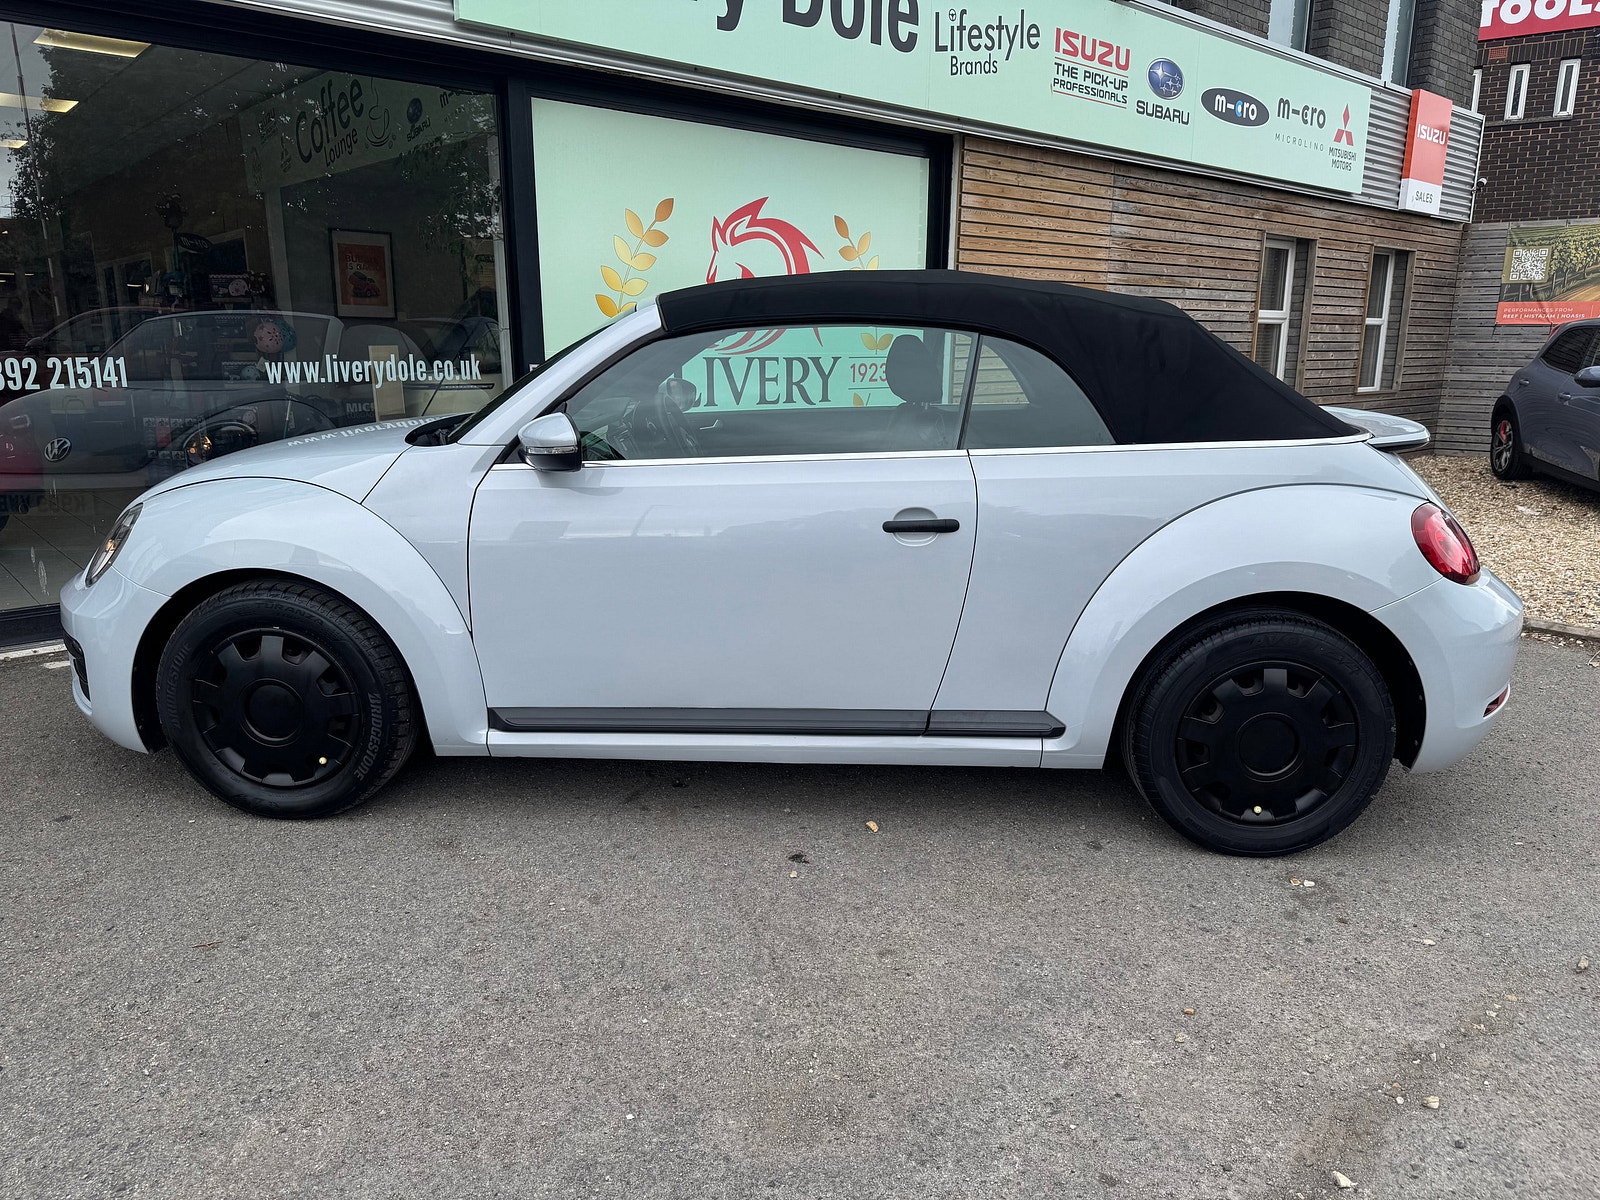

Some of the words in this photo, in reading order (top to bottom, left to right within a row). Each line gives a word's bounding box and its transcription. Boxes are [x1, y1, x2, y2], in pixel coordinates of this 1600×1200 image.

[1480, 0, 1600, 28] TOOL
[934, 8, 1041, 61] Lifestyle
[1055, 27, 1131, 72] ISUZU
[950, 52, 998, 76] Brands
[1054, 62, 1079, 80] THE
[1083, 69, 1129, 92] PICK-UP
[1053, 77, 1128, 104] PROFESSIONALS
[296, 79, 364, 164] Coffee
[1136, 100, 1190, 126] SUBARU
[1274, 133, 1324, 152] MICROLINO
[1417, 123, 1447, 145] ISUZU
[1328, 146, 1357, 162] MITSUBISHI
[1331, 158, 1352, 172] MOTORS
[1415, 190, 1433, 204] SALES
[46, 356, 128, 390] 215141
[264, 353, 482, 389] www.liverydole.co.uk
[692, 356, 842, 408] IVERY
[850, 362, 888, 384] 1923
[346, 402, 374, 413] MIC
[353, 692, 383, 781] BRIDGESTONE
